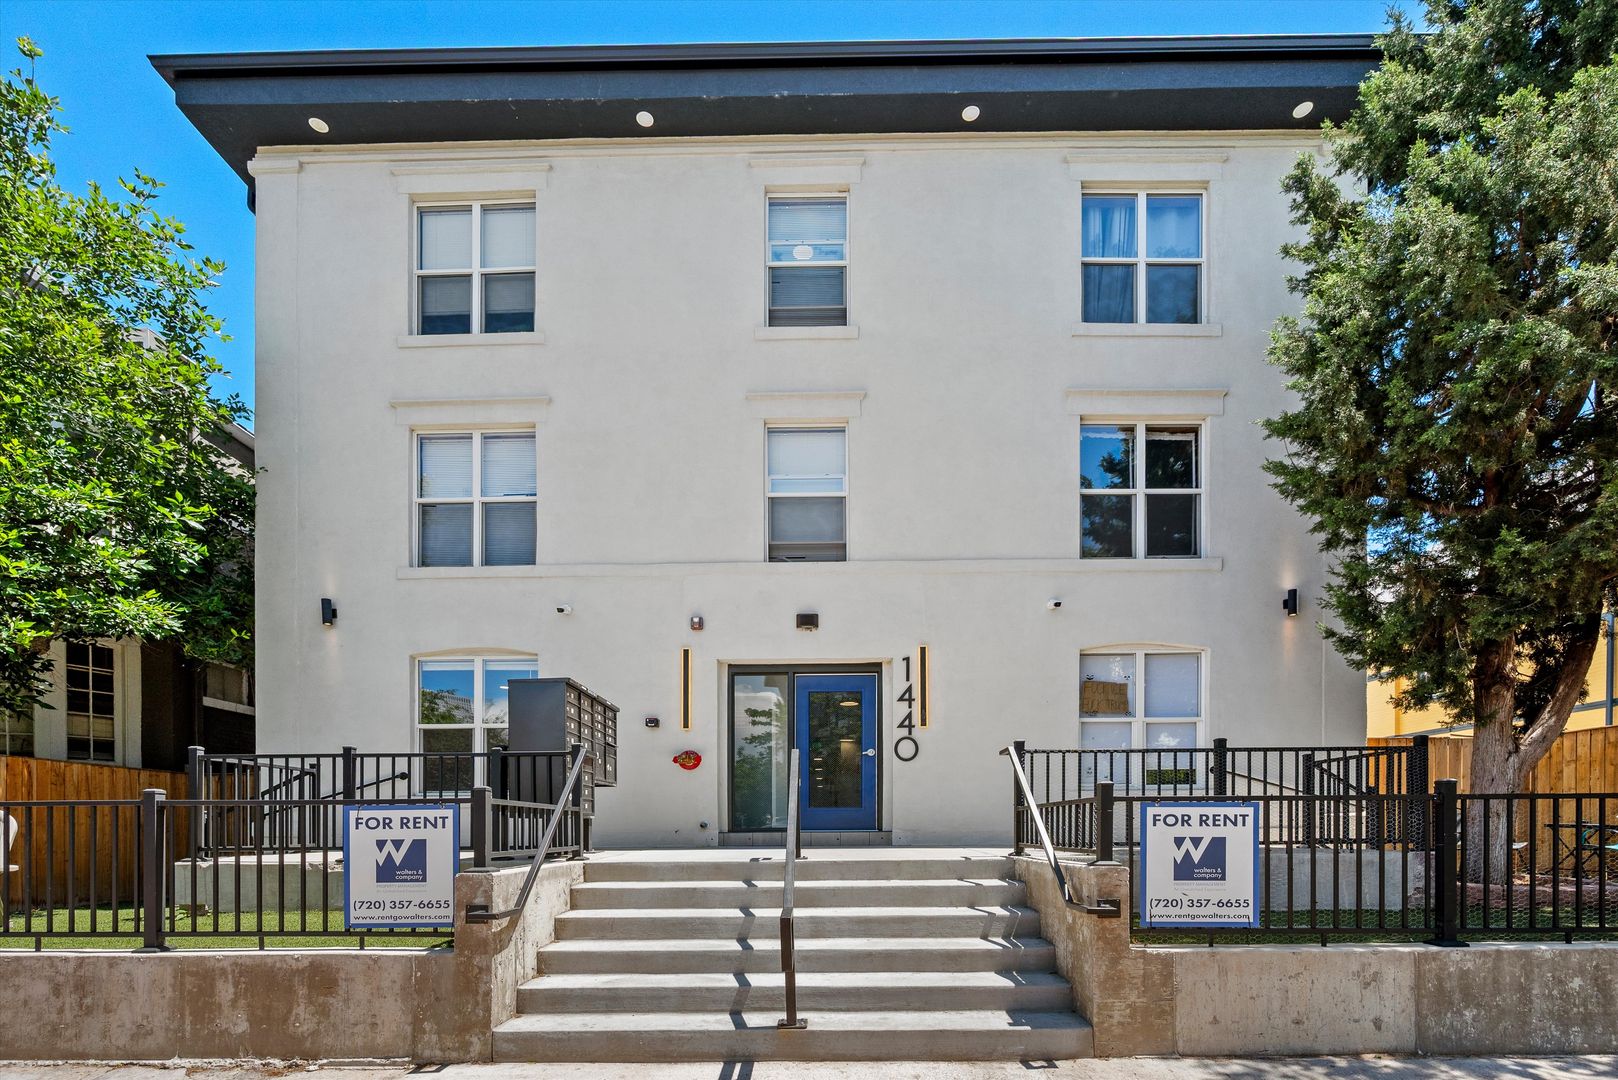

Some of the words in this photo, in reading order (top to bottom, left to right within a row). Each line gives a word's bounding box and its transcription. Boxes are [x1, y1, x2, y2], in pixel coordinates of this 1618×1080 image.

[894, 656, 919, 762] 1440
[355, 817, 393, 830] FOR
[400, 816, 448, 829] RENT
[1152, 814, 1192, 827] FOR
[1199, 814, 1249, 827] RENT
[353, 900, 386, 911] (720)
[389, 900, 450, 910] 357-6655
[1150, 898, 1183, 909] (720)
[1187, 898, 1250, 908] 357-6655
